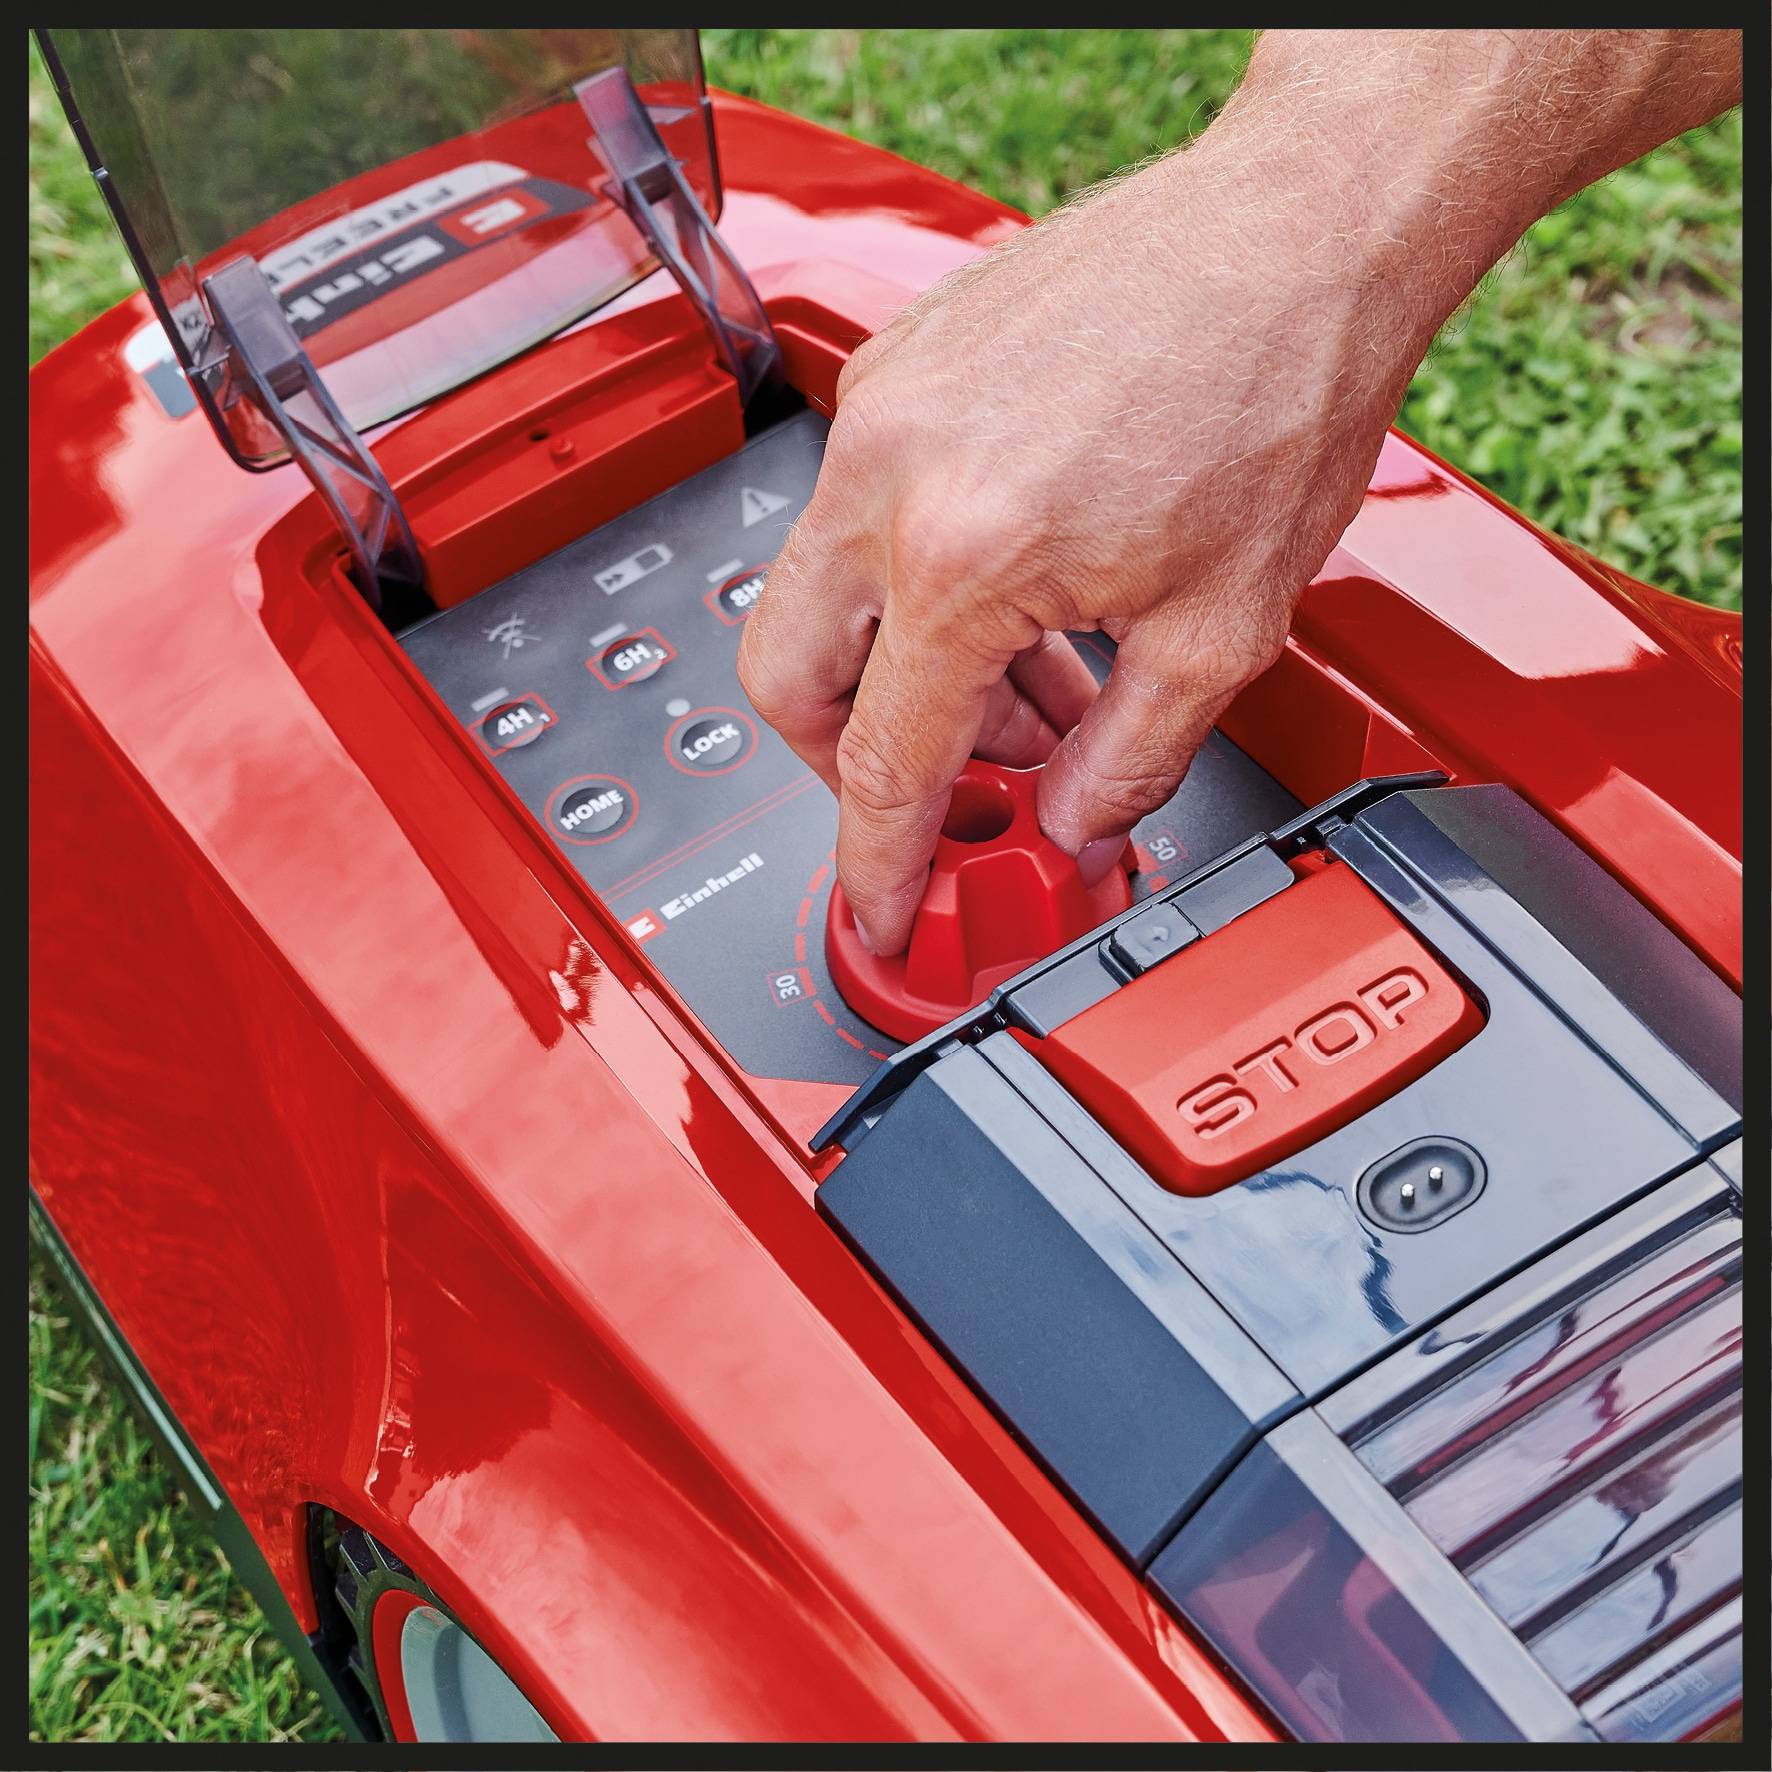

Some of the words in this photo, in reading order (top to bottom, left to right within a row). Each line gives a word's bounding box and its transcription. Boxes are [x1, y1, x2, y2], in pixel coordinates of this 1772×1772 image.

[285, 235, 446, 324] Einh
[613, 643, 651, 671] 6H
[497, 707, 534, 736] 4H
[682, 722, 740, 761] LOCK
[559, 789, 624, 831] HOME
[1148, 836, 1177, 861] 50
[659, 852, 765, 920] Einhell
[774, 974, 800, 999] 30
[1175, 966, 1429, 1140] STOP
